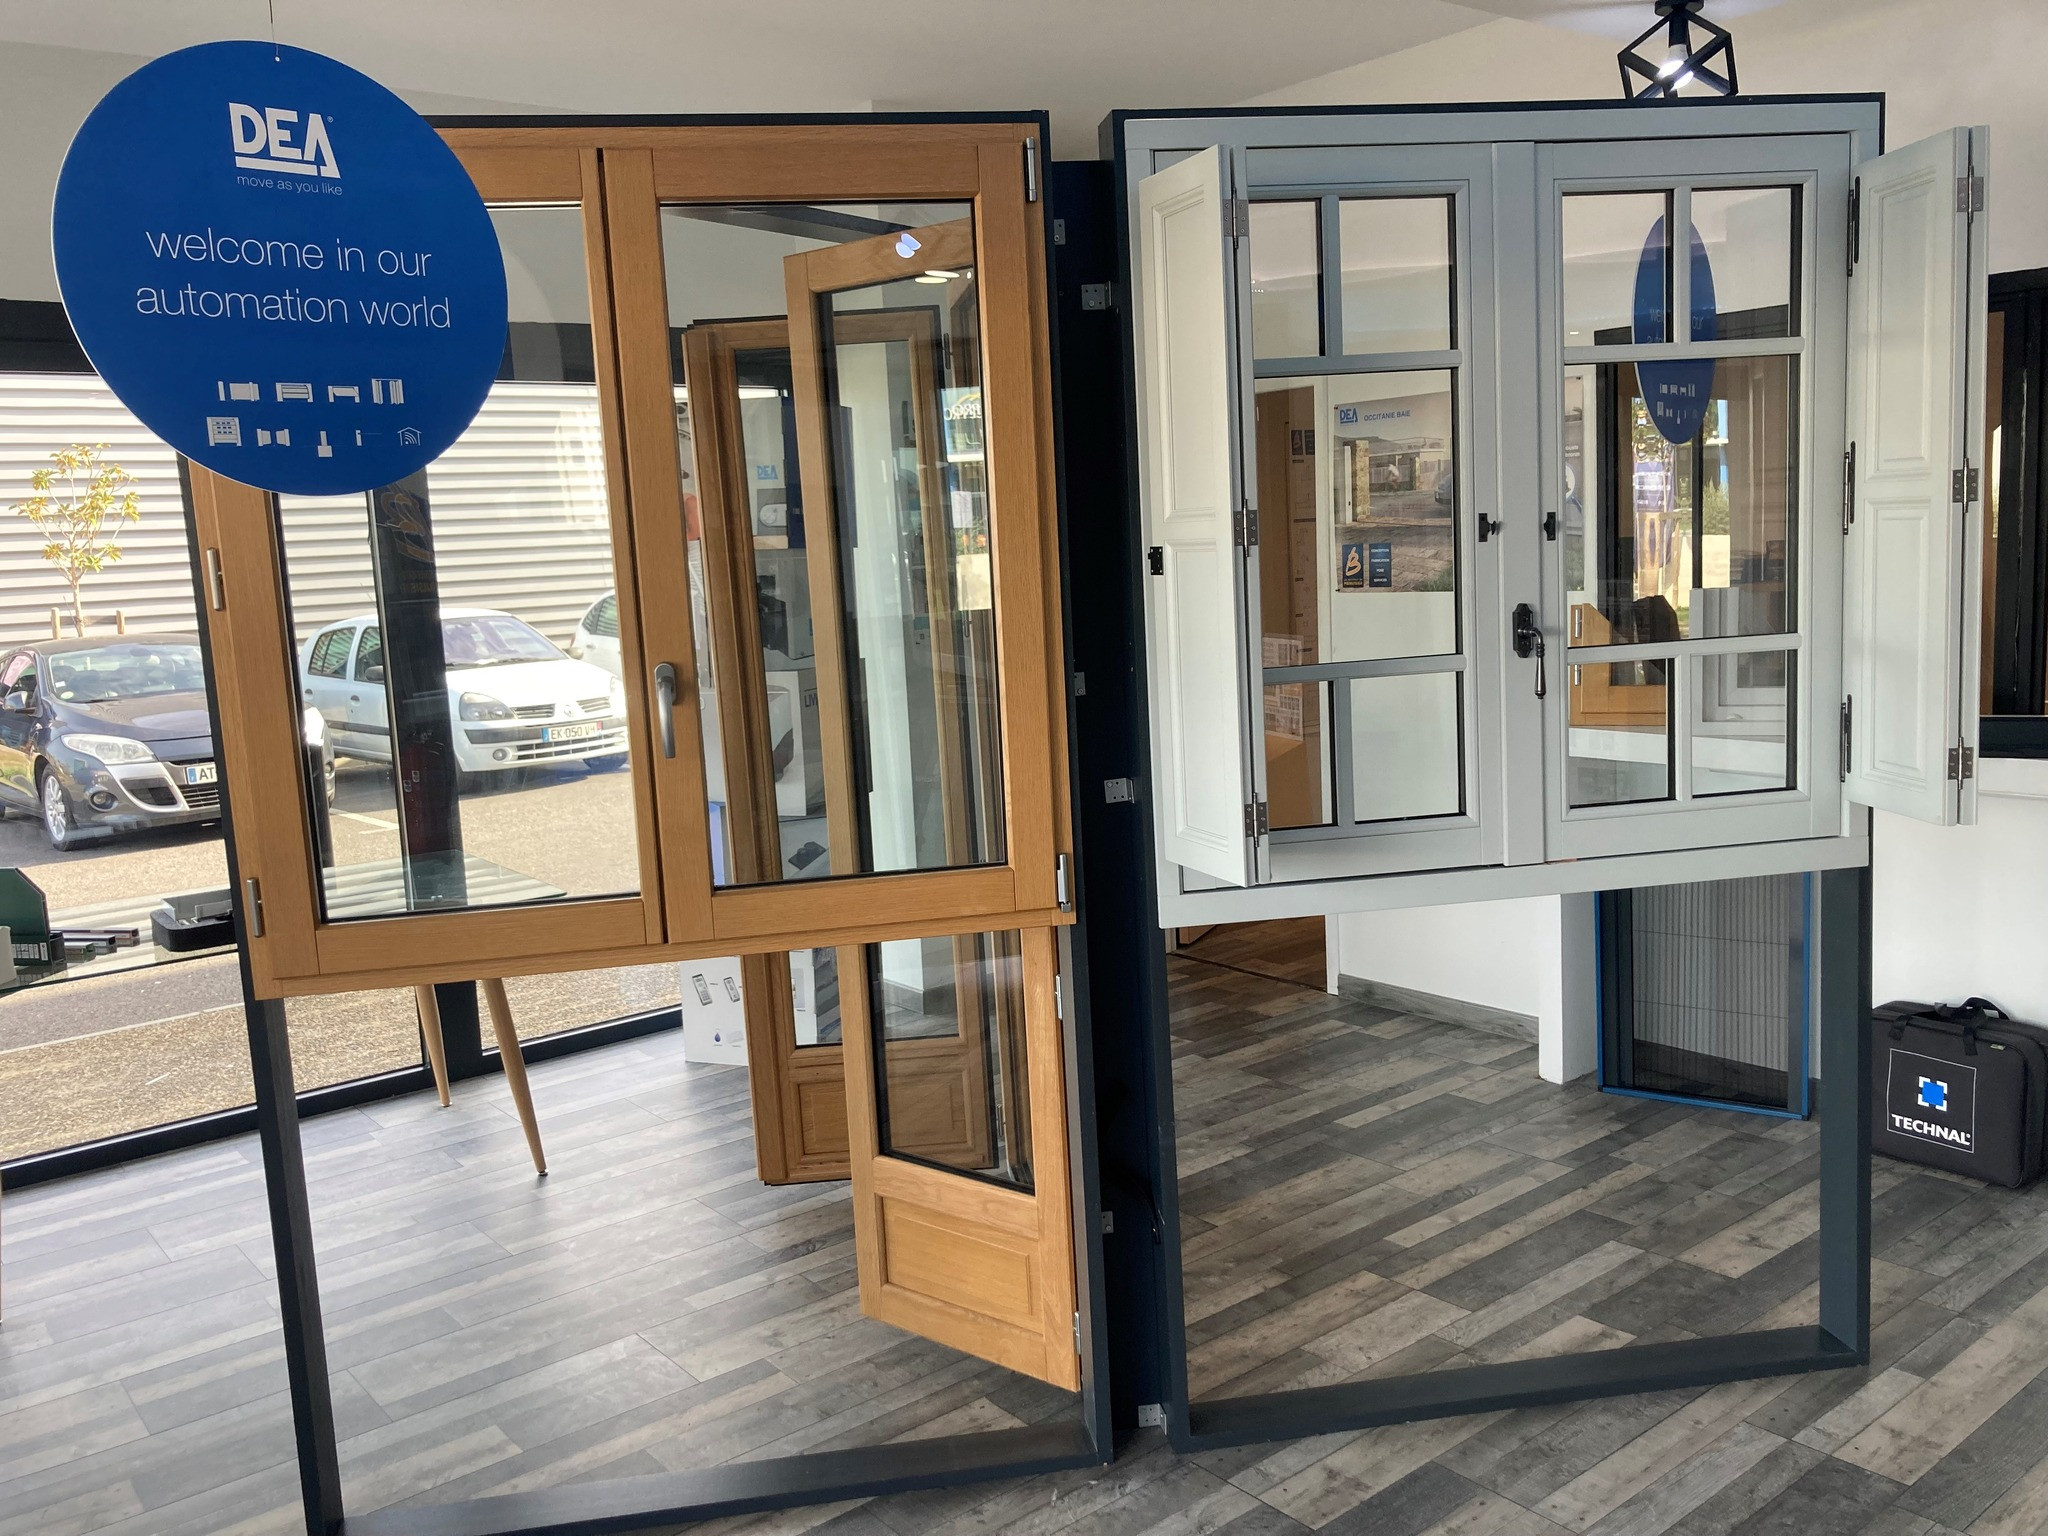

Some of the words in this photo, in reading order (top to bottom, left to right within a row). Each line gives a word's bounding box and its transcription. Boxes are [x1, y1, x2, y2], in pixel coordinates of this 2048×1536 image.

[237, 176, 274, 189] move
[277, 180, 293, 191] as
[295, 182, 319, 194] you
[321, 183, 343, 196] like
[145, 226, 324, 270] welcome
[336, 238, 365, 272] in
[377, 249, 432, 277] our
[136, 282, 349, 324] automation
[359, 295, 451, 329] world
[1339, 407, 1359, 424] DEA
[1363, 412, 1396, 422] OCCITANIE
[1397, 410, 1411, 418] BAIE
[756, 464, 779, 480] DEA
[550, 728, 563, 740] EK
[565, 726, 583, 738] 050
[199, 766, 215, 781] AT
[1891, 1113, 1972, 1146] TECHNAL
